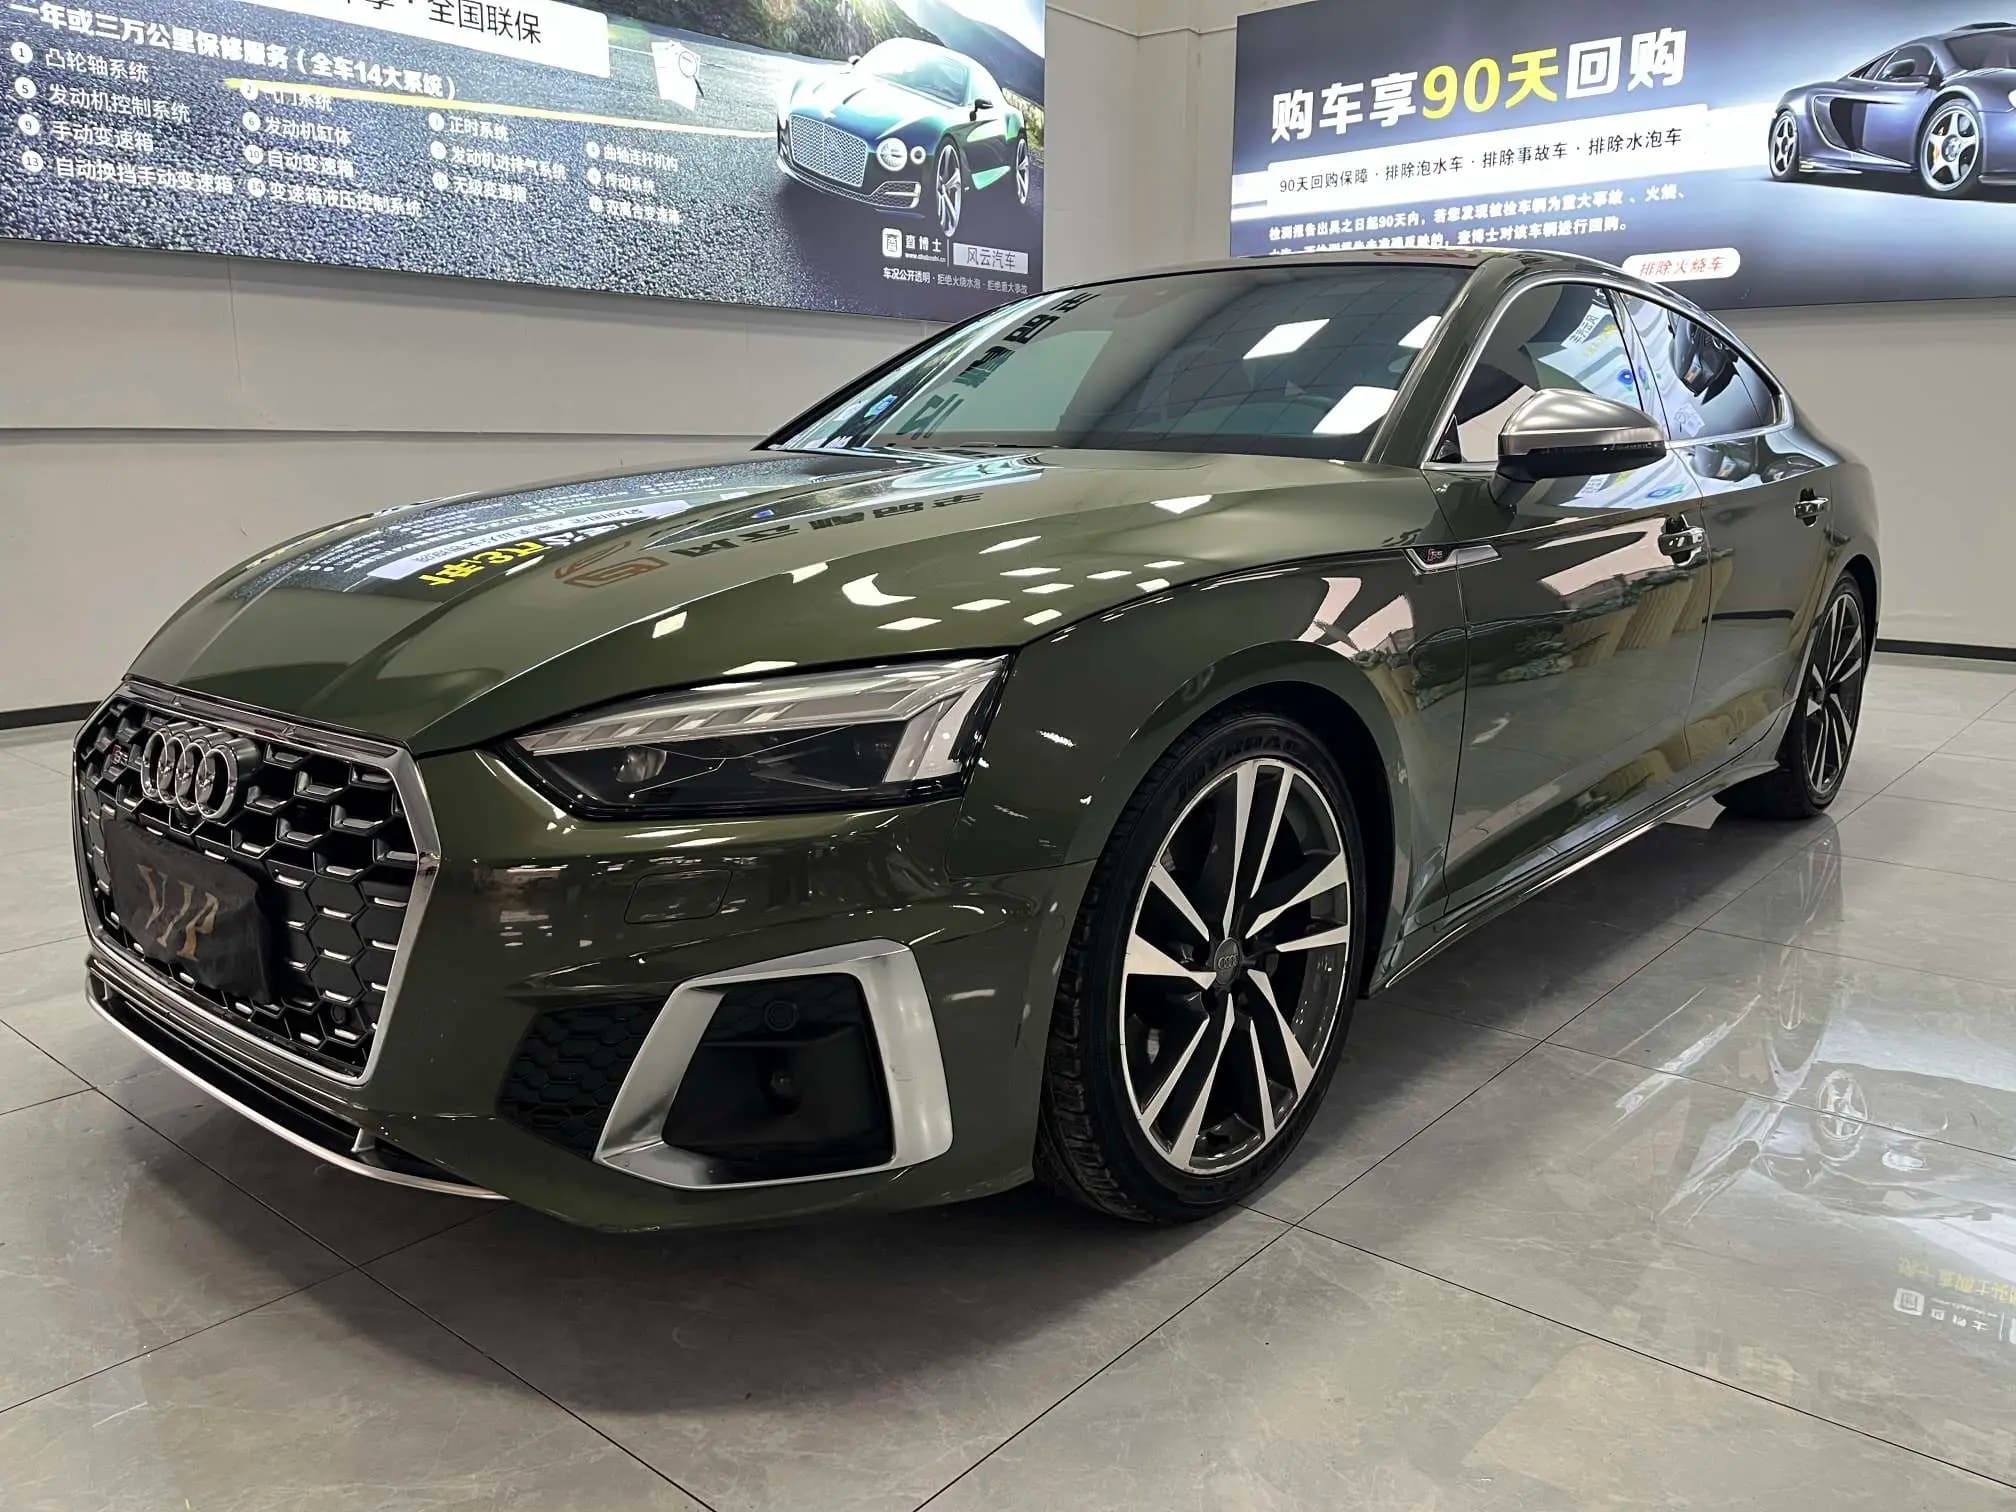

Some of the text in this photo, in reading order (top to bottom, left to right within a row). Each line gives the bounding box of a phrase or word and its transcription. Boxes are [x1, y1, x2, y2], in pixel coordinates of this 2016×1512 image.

[45, 48, 149, 83] 凸轮轴系统
[1271, 27, 1688, 144] 购车享90天回购
[50, 83, 192, 124] 发动机控制系统
[51, 120, 154, 152] 手动变速箱
[264, 115, 353, 147] 发动机缸体
[56, 158, 233, 195] 自动换挡手动变速箱
[268, 150, 354, 179] 自动变速箱
[967, 247, 1016, 271] 风云汽车
